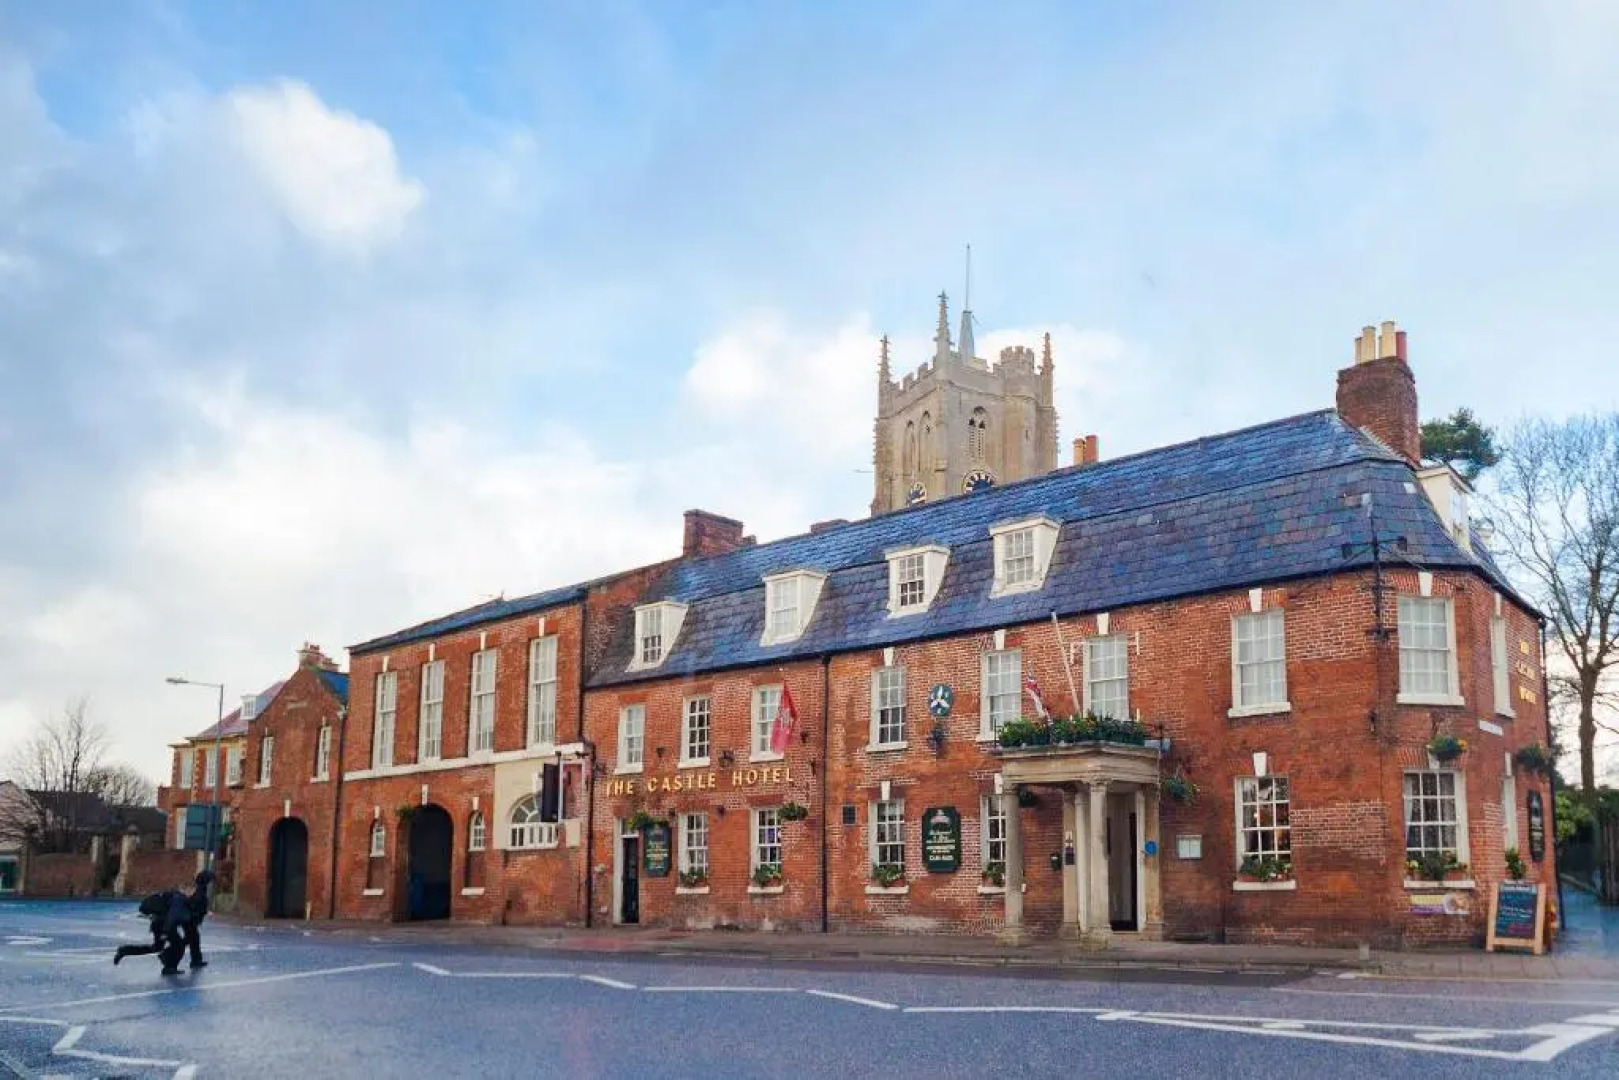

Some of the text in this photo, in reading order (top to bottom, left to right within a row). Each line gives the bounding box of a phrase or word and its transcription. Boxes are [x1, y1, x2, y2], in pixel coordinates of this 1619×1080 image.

[606, 768, 794, 796] THE CASTLE HOTEL
